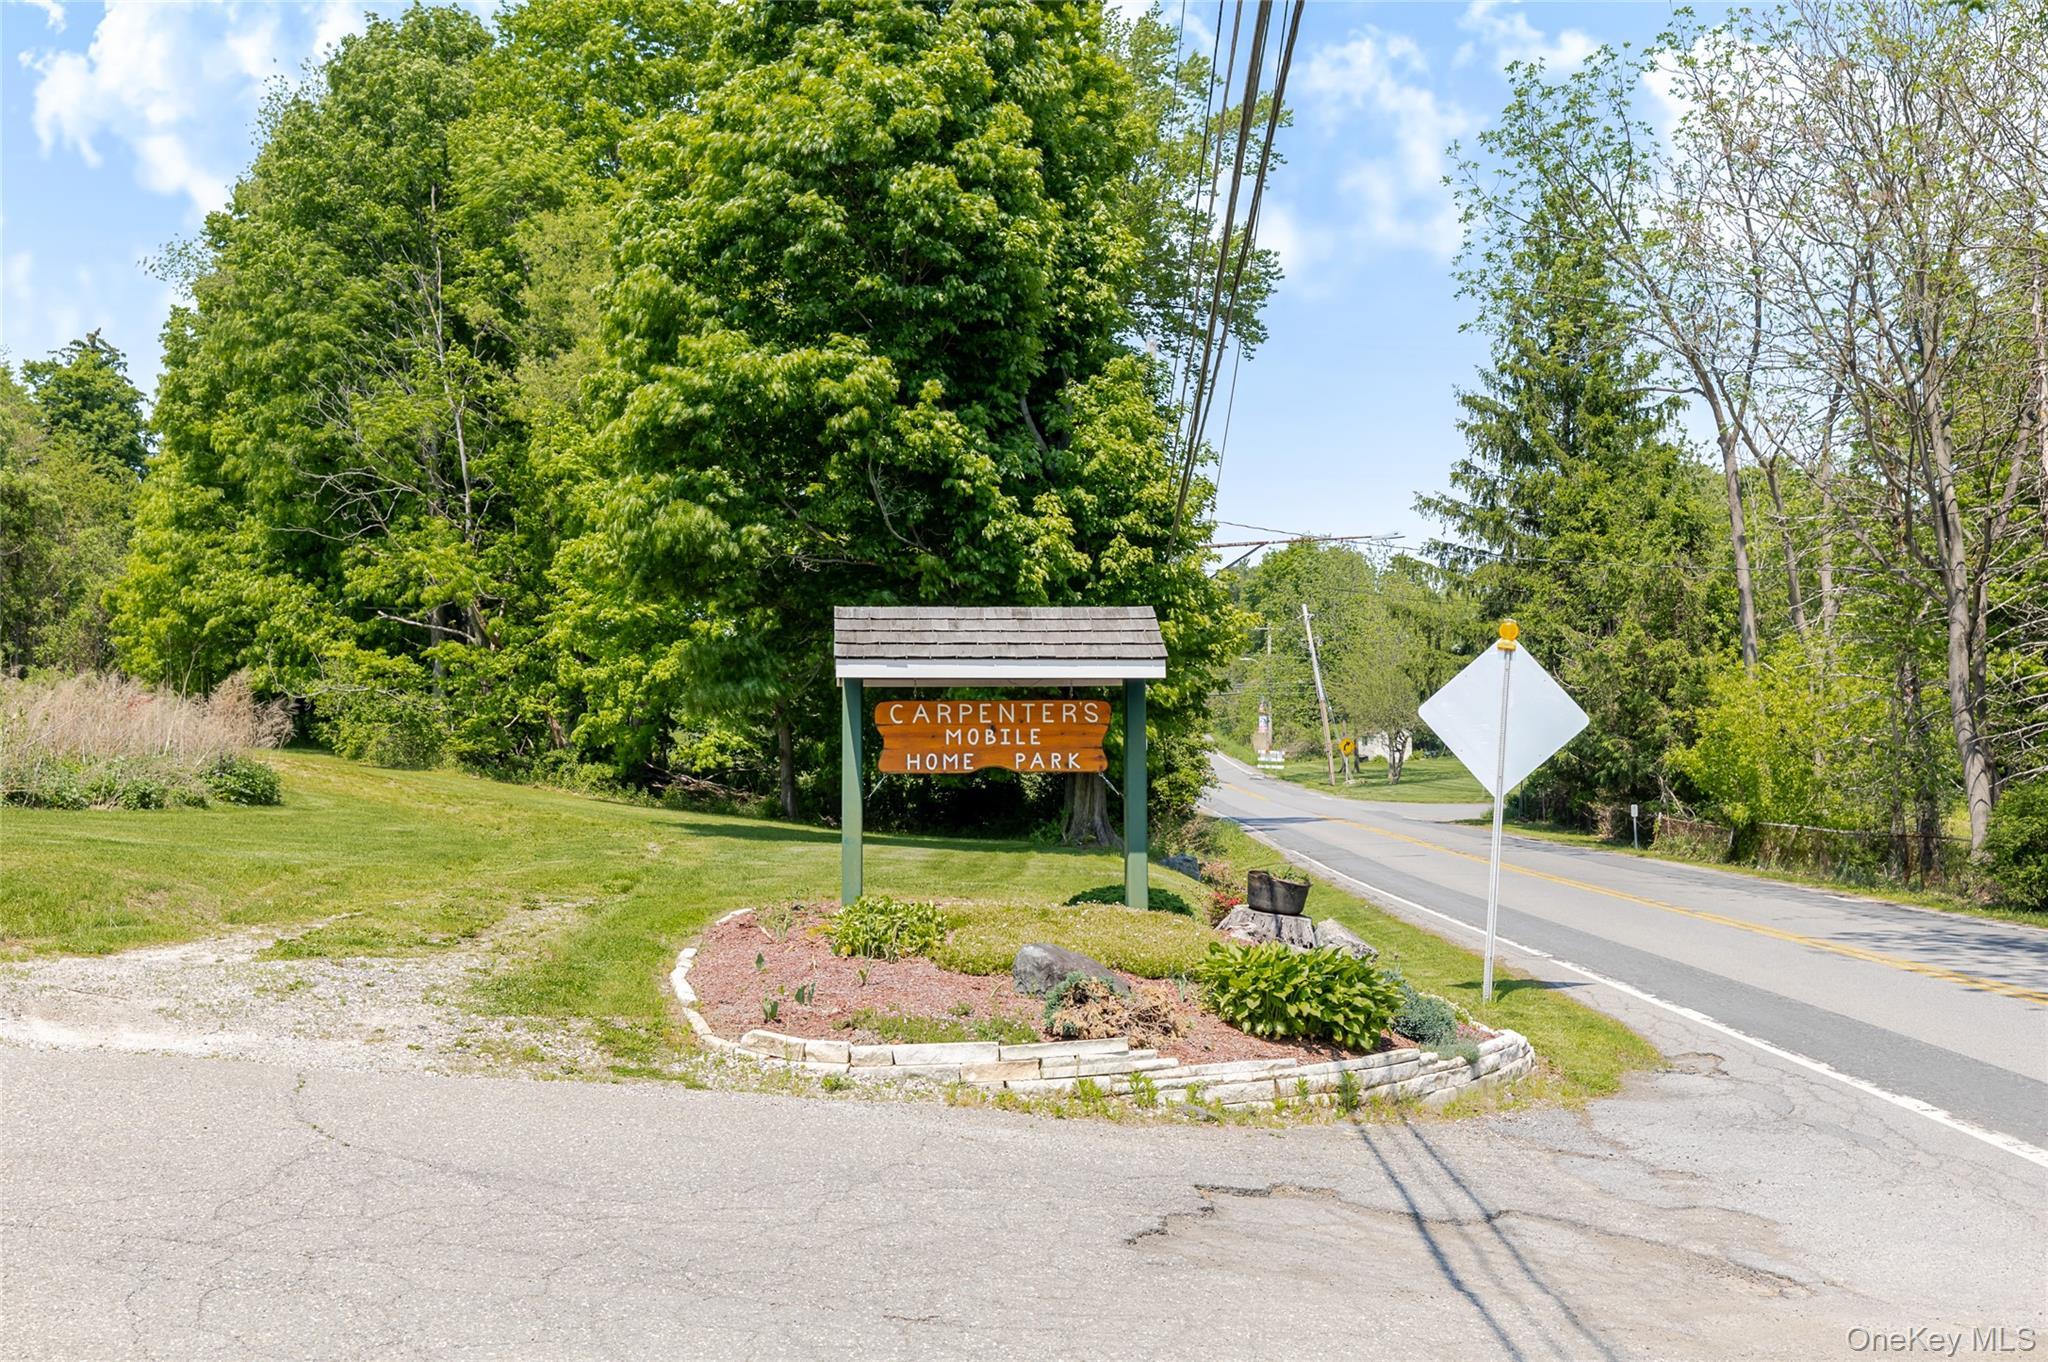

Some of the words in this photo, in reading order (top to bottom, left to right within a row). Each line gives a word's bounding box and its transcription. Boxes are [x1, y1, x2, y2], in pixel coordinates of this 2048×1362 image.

[889, 702, 1099, 724] CARPENTER'S
[945, 728, 1041, 745] MOBILE
[906, 753, 975, 770] HOME
[1015, 752, 1081, 769] PARK
